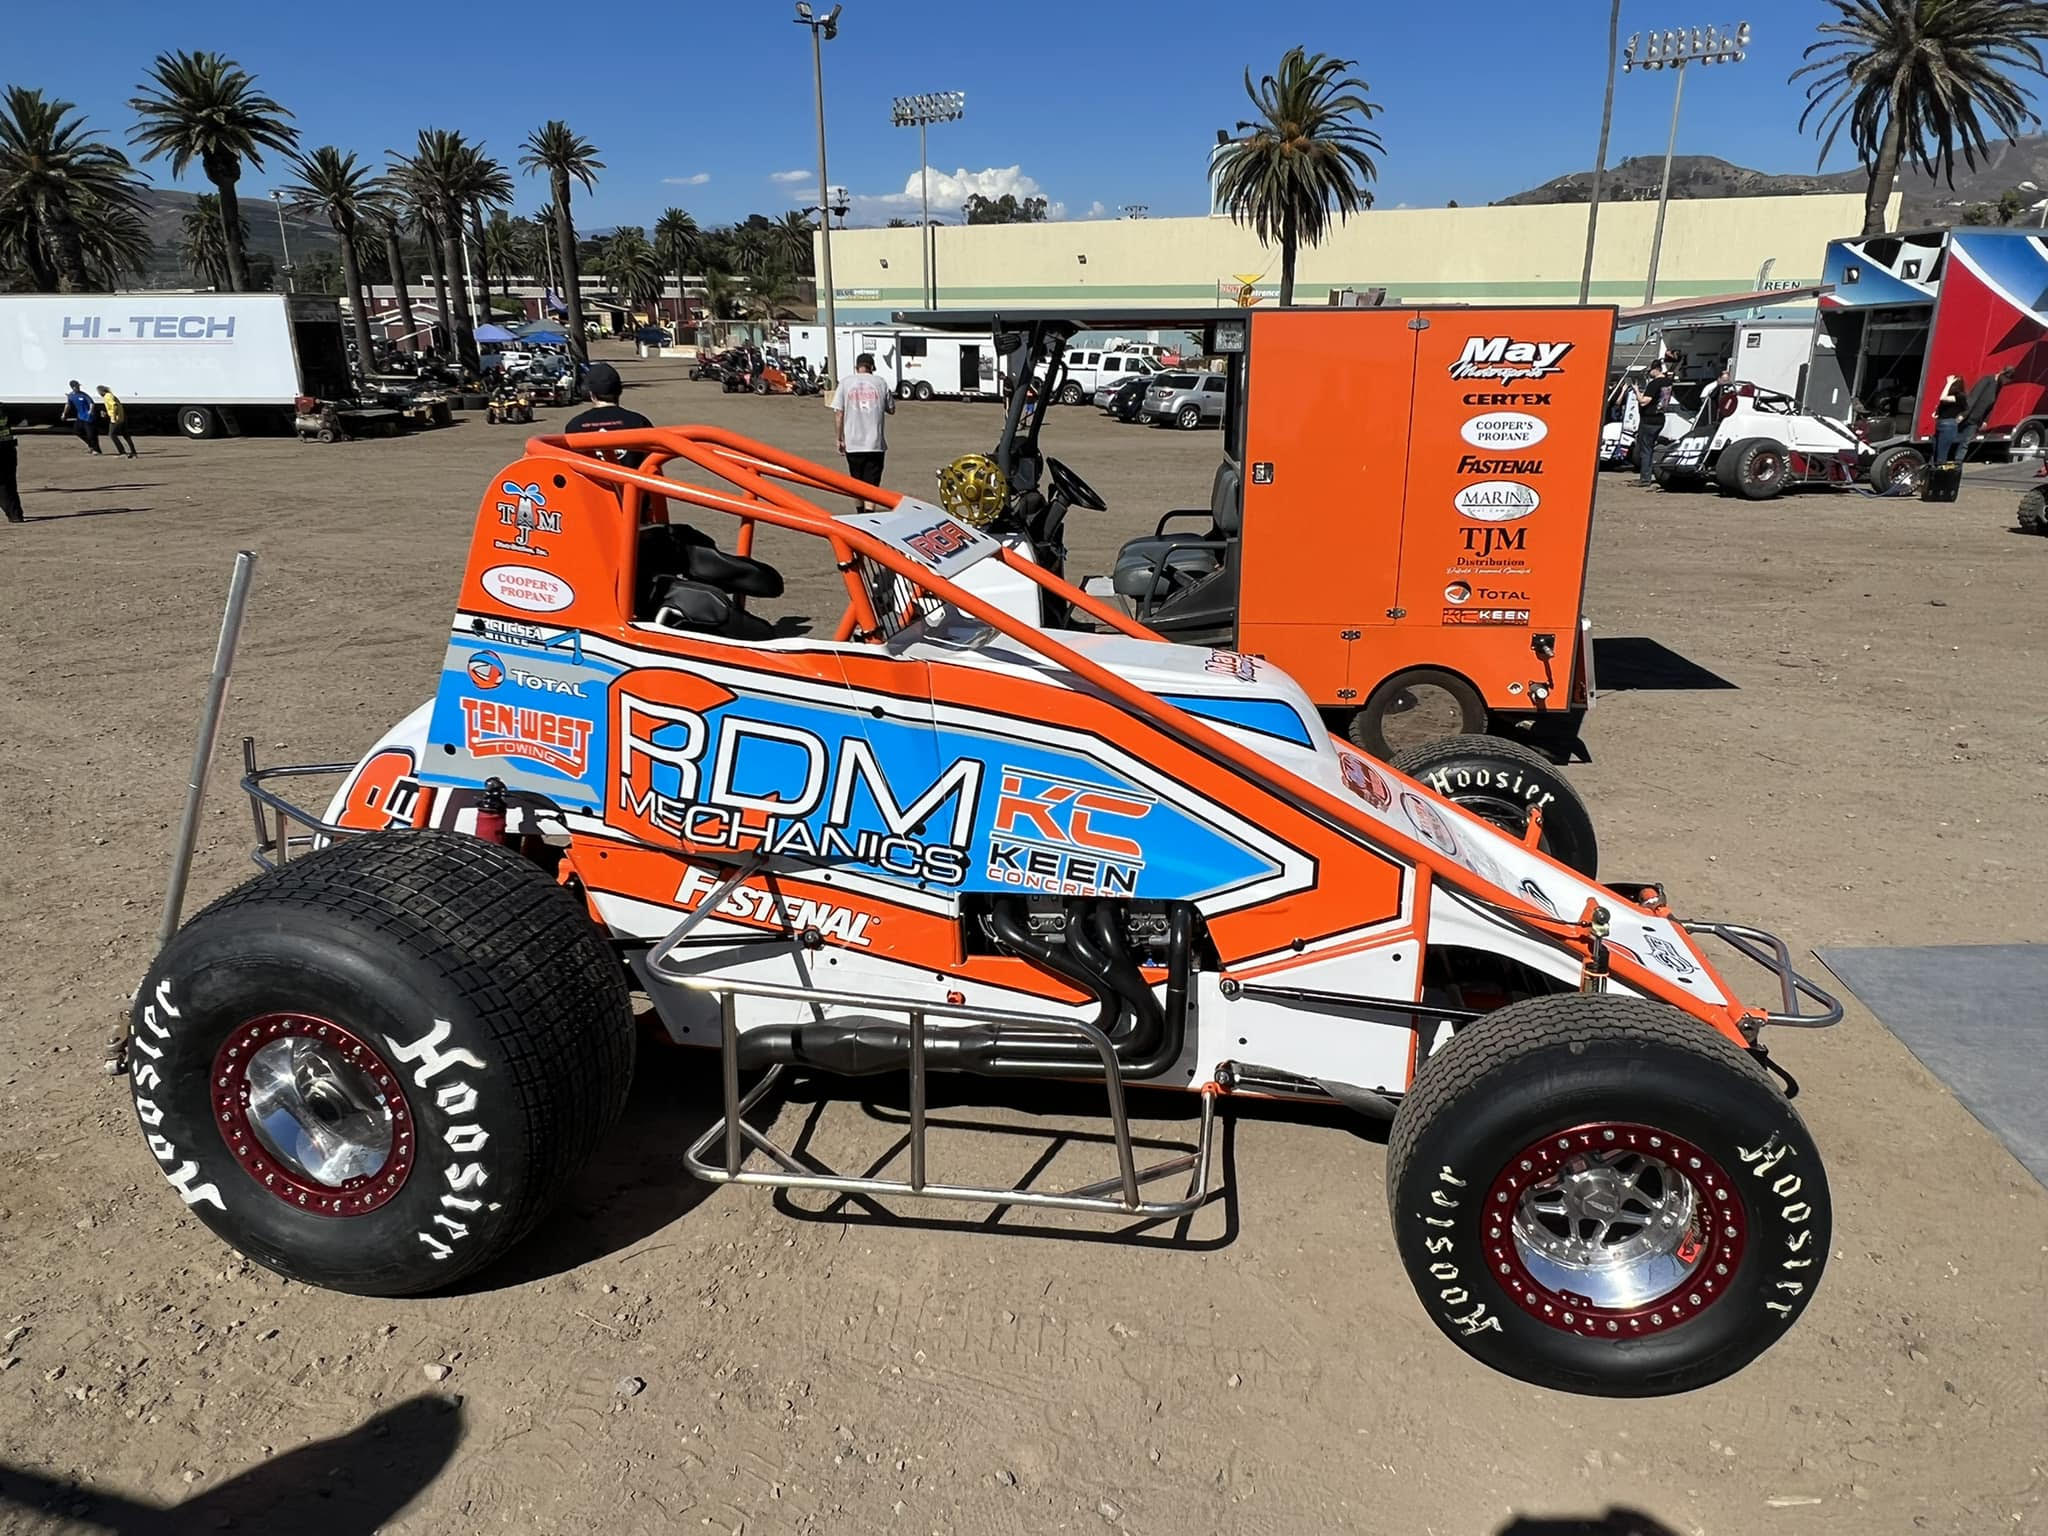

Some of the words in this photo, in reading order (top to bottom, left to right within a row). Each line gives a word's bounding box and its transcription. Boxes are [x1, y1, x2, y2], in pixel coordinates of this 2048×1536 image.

[1459, 336, 1575, 367] May
[1463, 394, 1552, 405] CERTEX
[1476, 421, 1533, 431] COOPER'S
[1478, 432, 1530, 441] PROPANE
[1462, 491, 1535, 505] MARINA
[1459, 527, 1528, 557] TJM
[1457, 557, 1525, 567] Distribution
[498, 573, 559, 592] COOPER'S
[501, 586, 556, 604] PROPANE
[1479, 611, 1529, 620] KEEN
[496, 740, 558, 765] TOWING
[618, 685, 985, 848] RDM
[993, 774, 1152, 858] KC
[619, 776, 968, 887] MECHANICS
[987, 842, 1139, 893] KEEN
[986, 868, 1133, 897] CONCRET
